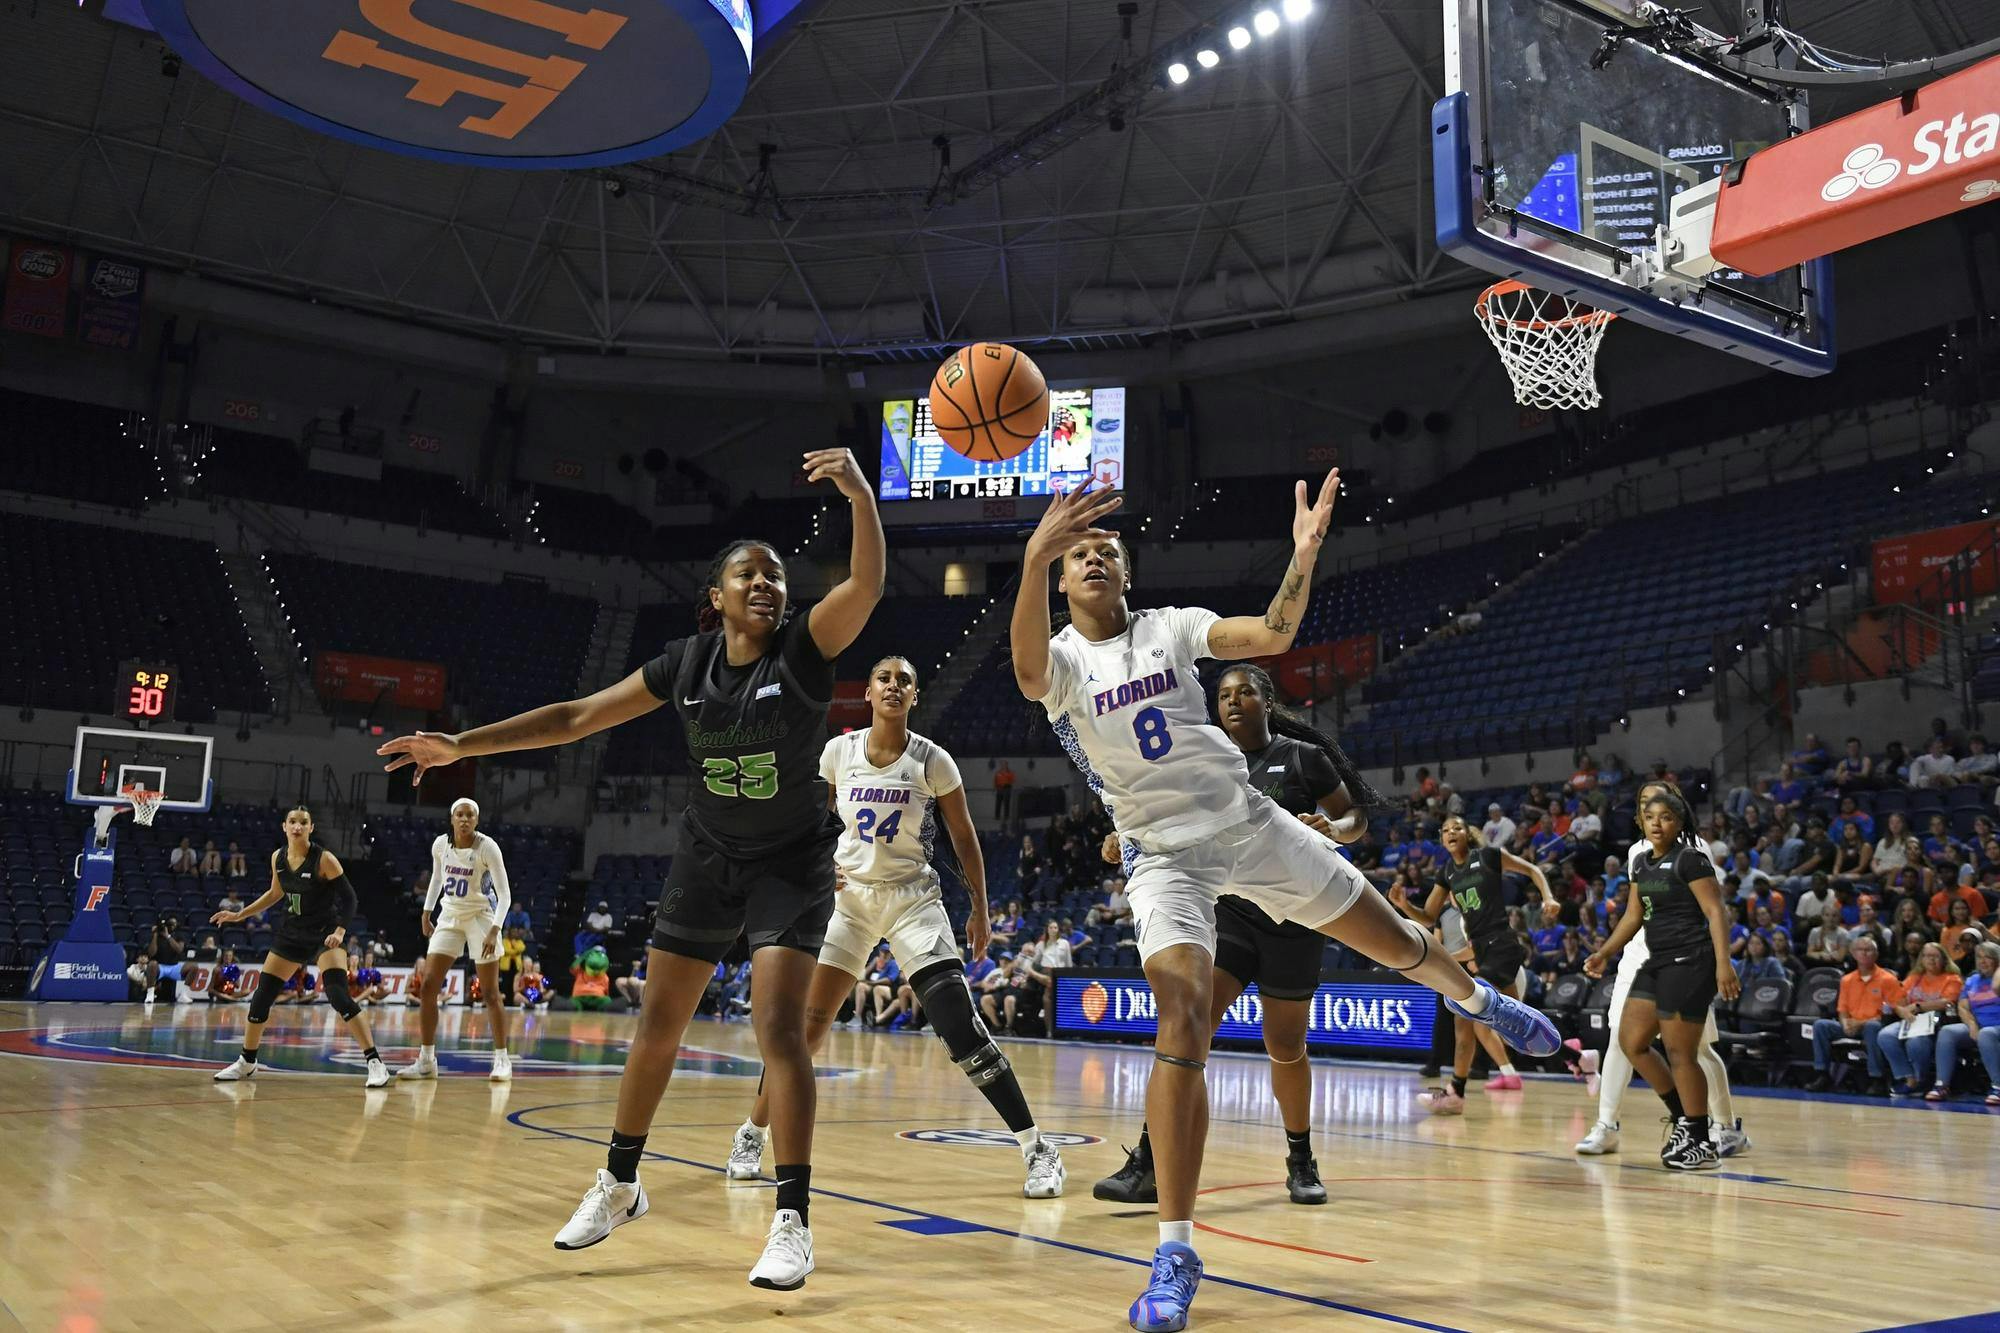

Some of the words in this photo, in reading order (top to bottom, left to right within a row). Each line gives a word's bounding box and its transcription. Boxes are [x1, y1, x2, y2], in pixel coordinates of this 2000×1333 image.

[225, 401, 259, 420] 206
[1094, 444, 1121, 455] LAW
[986, 478, 1014, 490] 9:12
[136, 671, 169, 690] 9:12
[129, 687, 163, 716] 30
[1093, 667, 1178, 718] FLORIDA
[687, 711, 789, 748] Southside
[1132, 706, 1173, 761] 8
[702, 751, 779, 800] 25
[848, 787, 912, 805] FLORIDA
[856, 807, 903, 845] 24
[445, 865, 474, 877] FLORIDA
[444, 877, 469, 897] 20
[83, 885, 110, 911] F
[71, 962, 99, 972] Florida
[71, 971, 97, 980] Credit
[97, 971, 123, 981] Union
